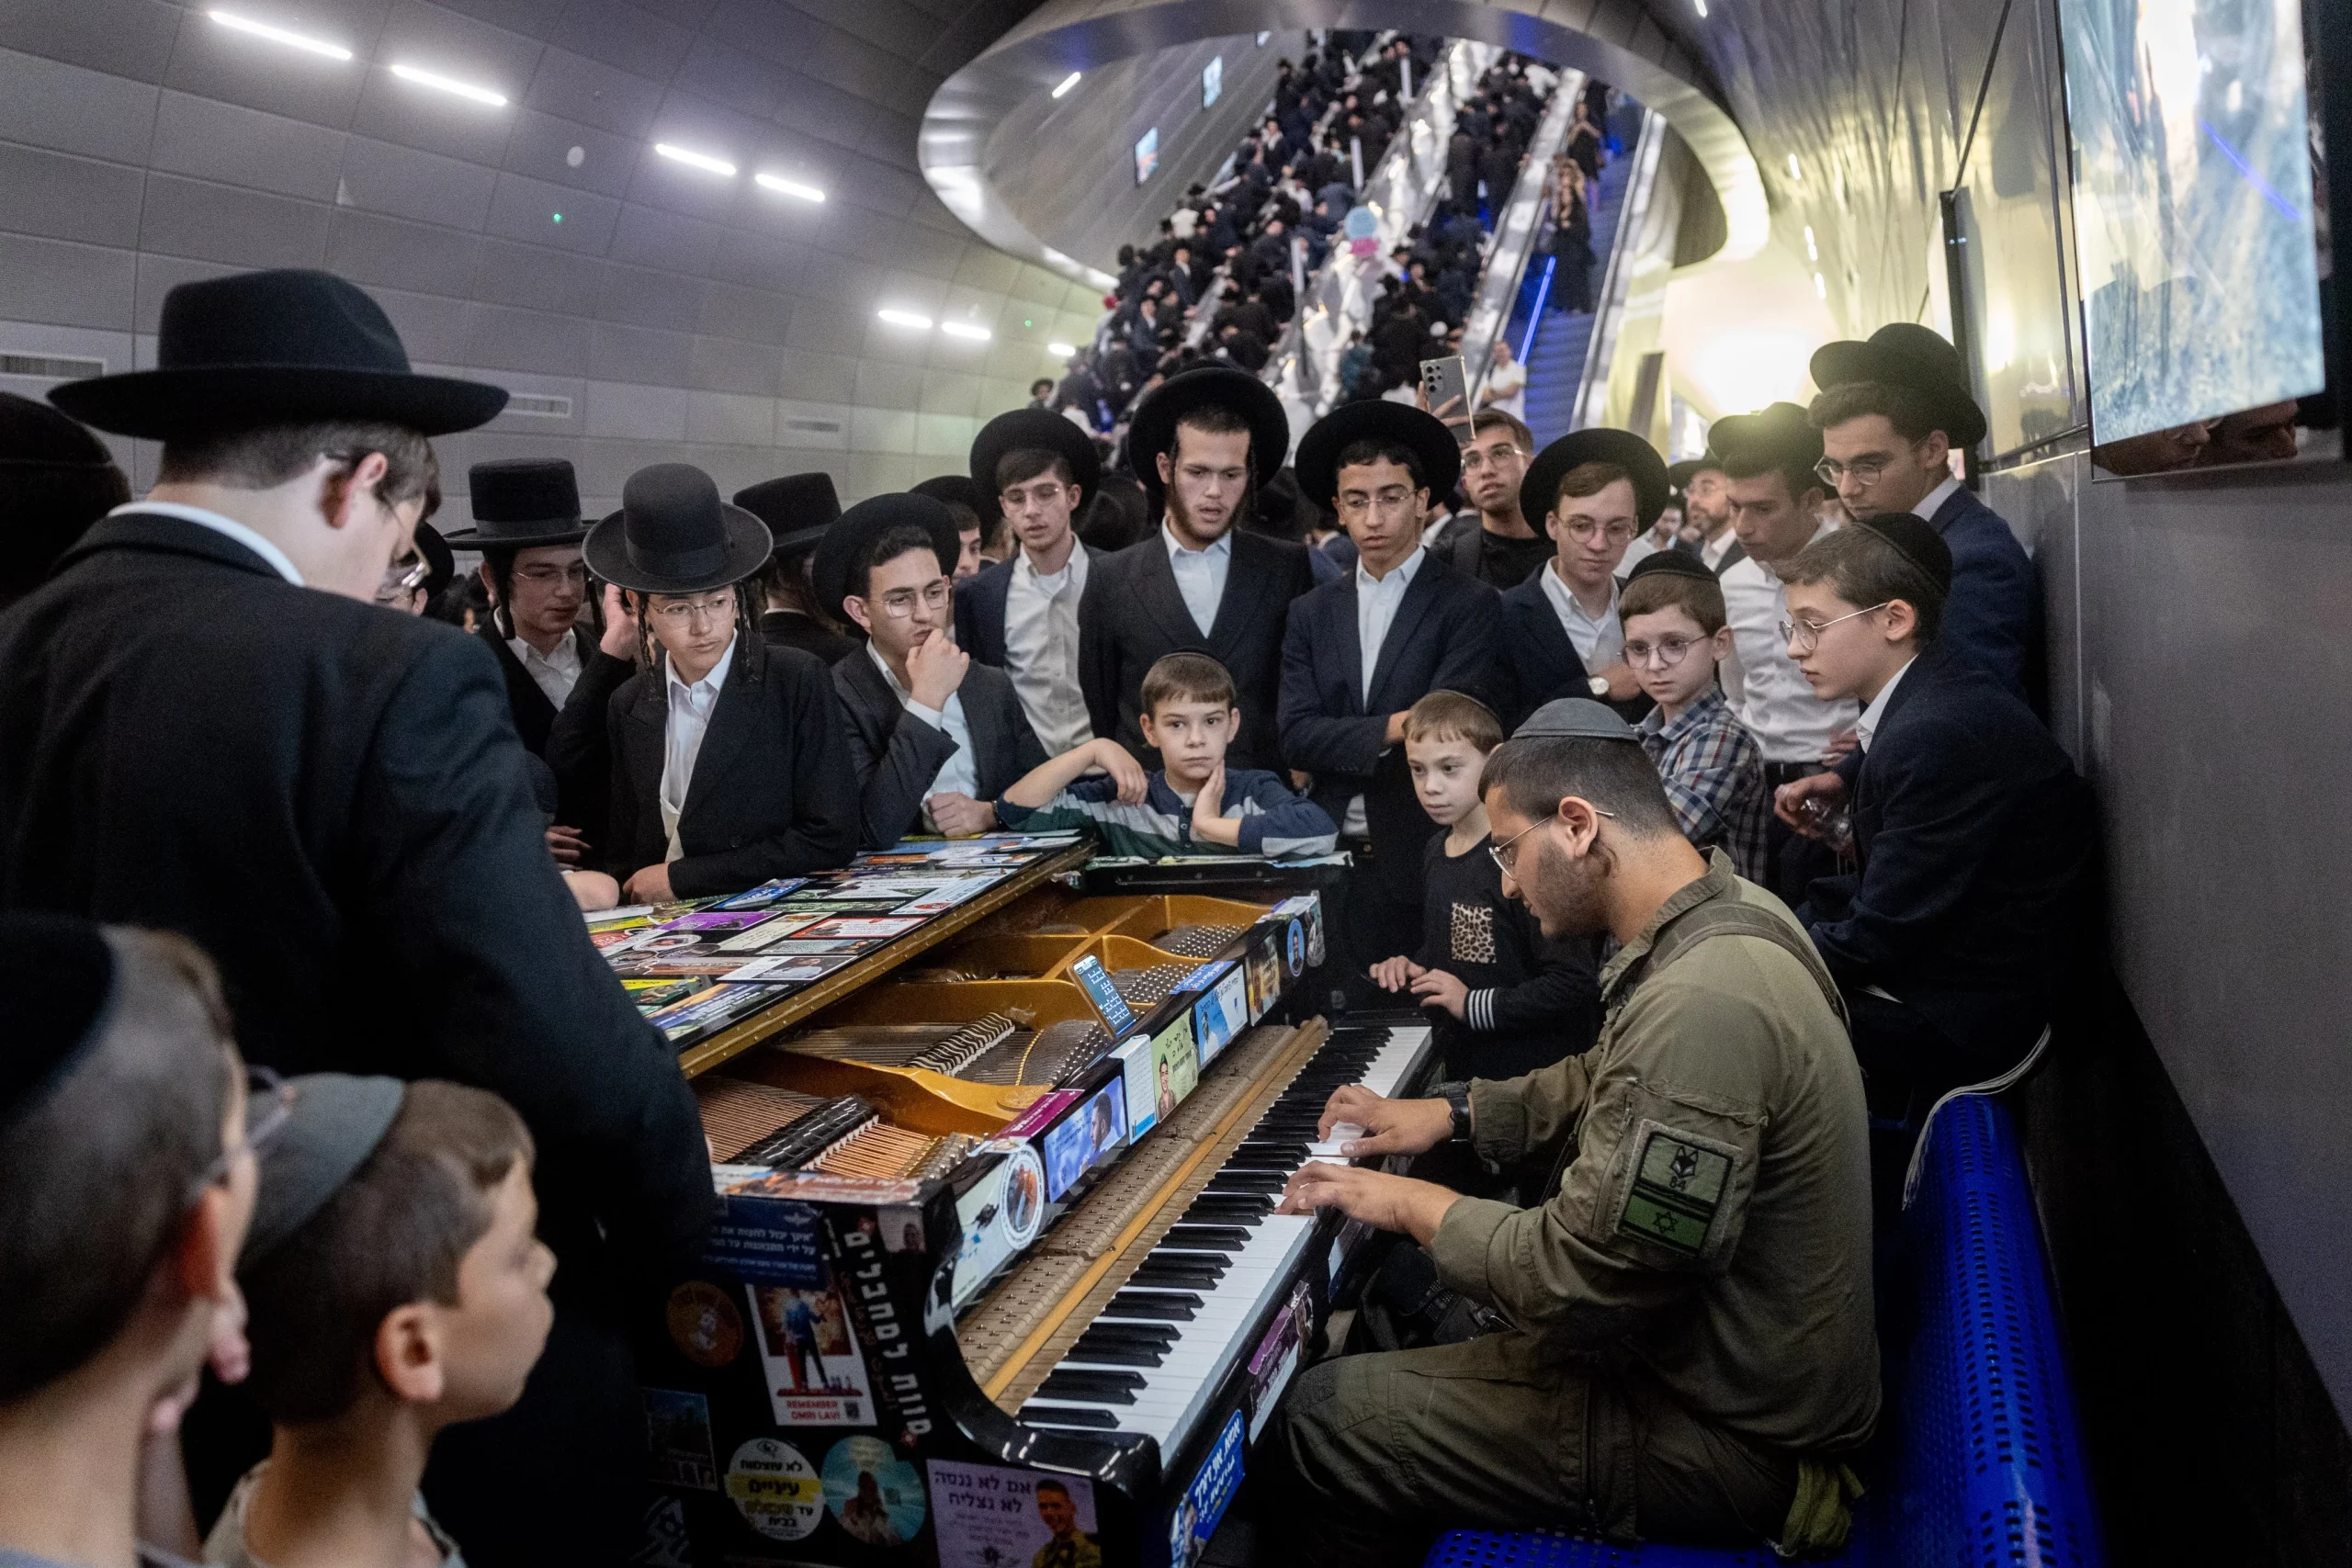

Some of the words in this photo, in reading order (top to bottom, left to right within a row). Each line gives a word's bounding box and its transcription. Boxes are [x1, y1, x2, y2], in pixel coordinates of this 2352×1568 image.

[1669, 1176, 1687, 1191] 84
[843, 1231, 909, 1359] למחבלים
[786, 1400, 838, 1410] REMEMBER
[890, 1371, 932, 1435] מוות
[791, 1411, 816, 1420] OMRI
[819, 1412, 841, 1420] LAVI
[786, 1461, 803, 1472] לא
[749, 1479, 800, 1496] עיניים
[934, 1471, 972, 1488] ננסה
[978, 1474, 1001, 1490] לא
[1006, 1479, 1032, 1495] אם
[948, 1492, 995, 1510] נצליח
[1001, 1495, 1023, 1513] לא
[797, 1506, 814, 1517] עד
[768, 1516, 797, 1528] בבית
